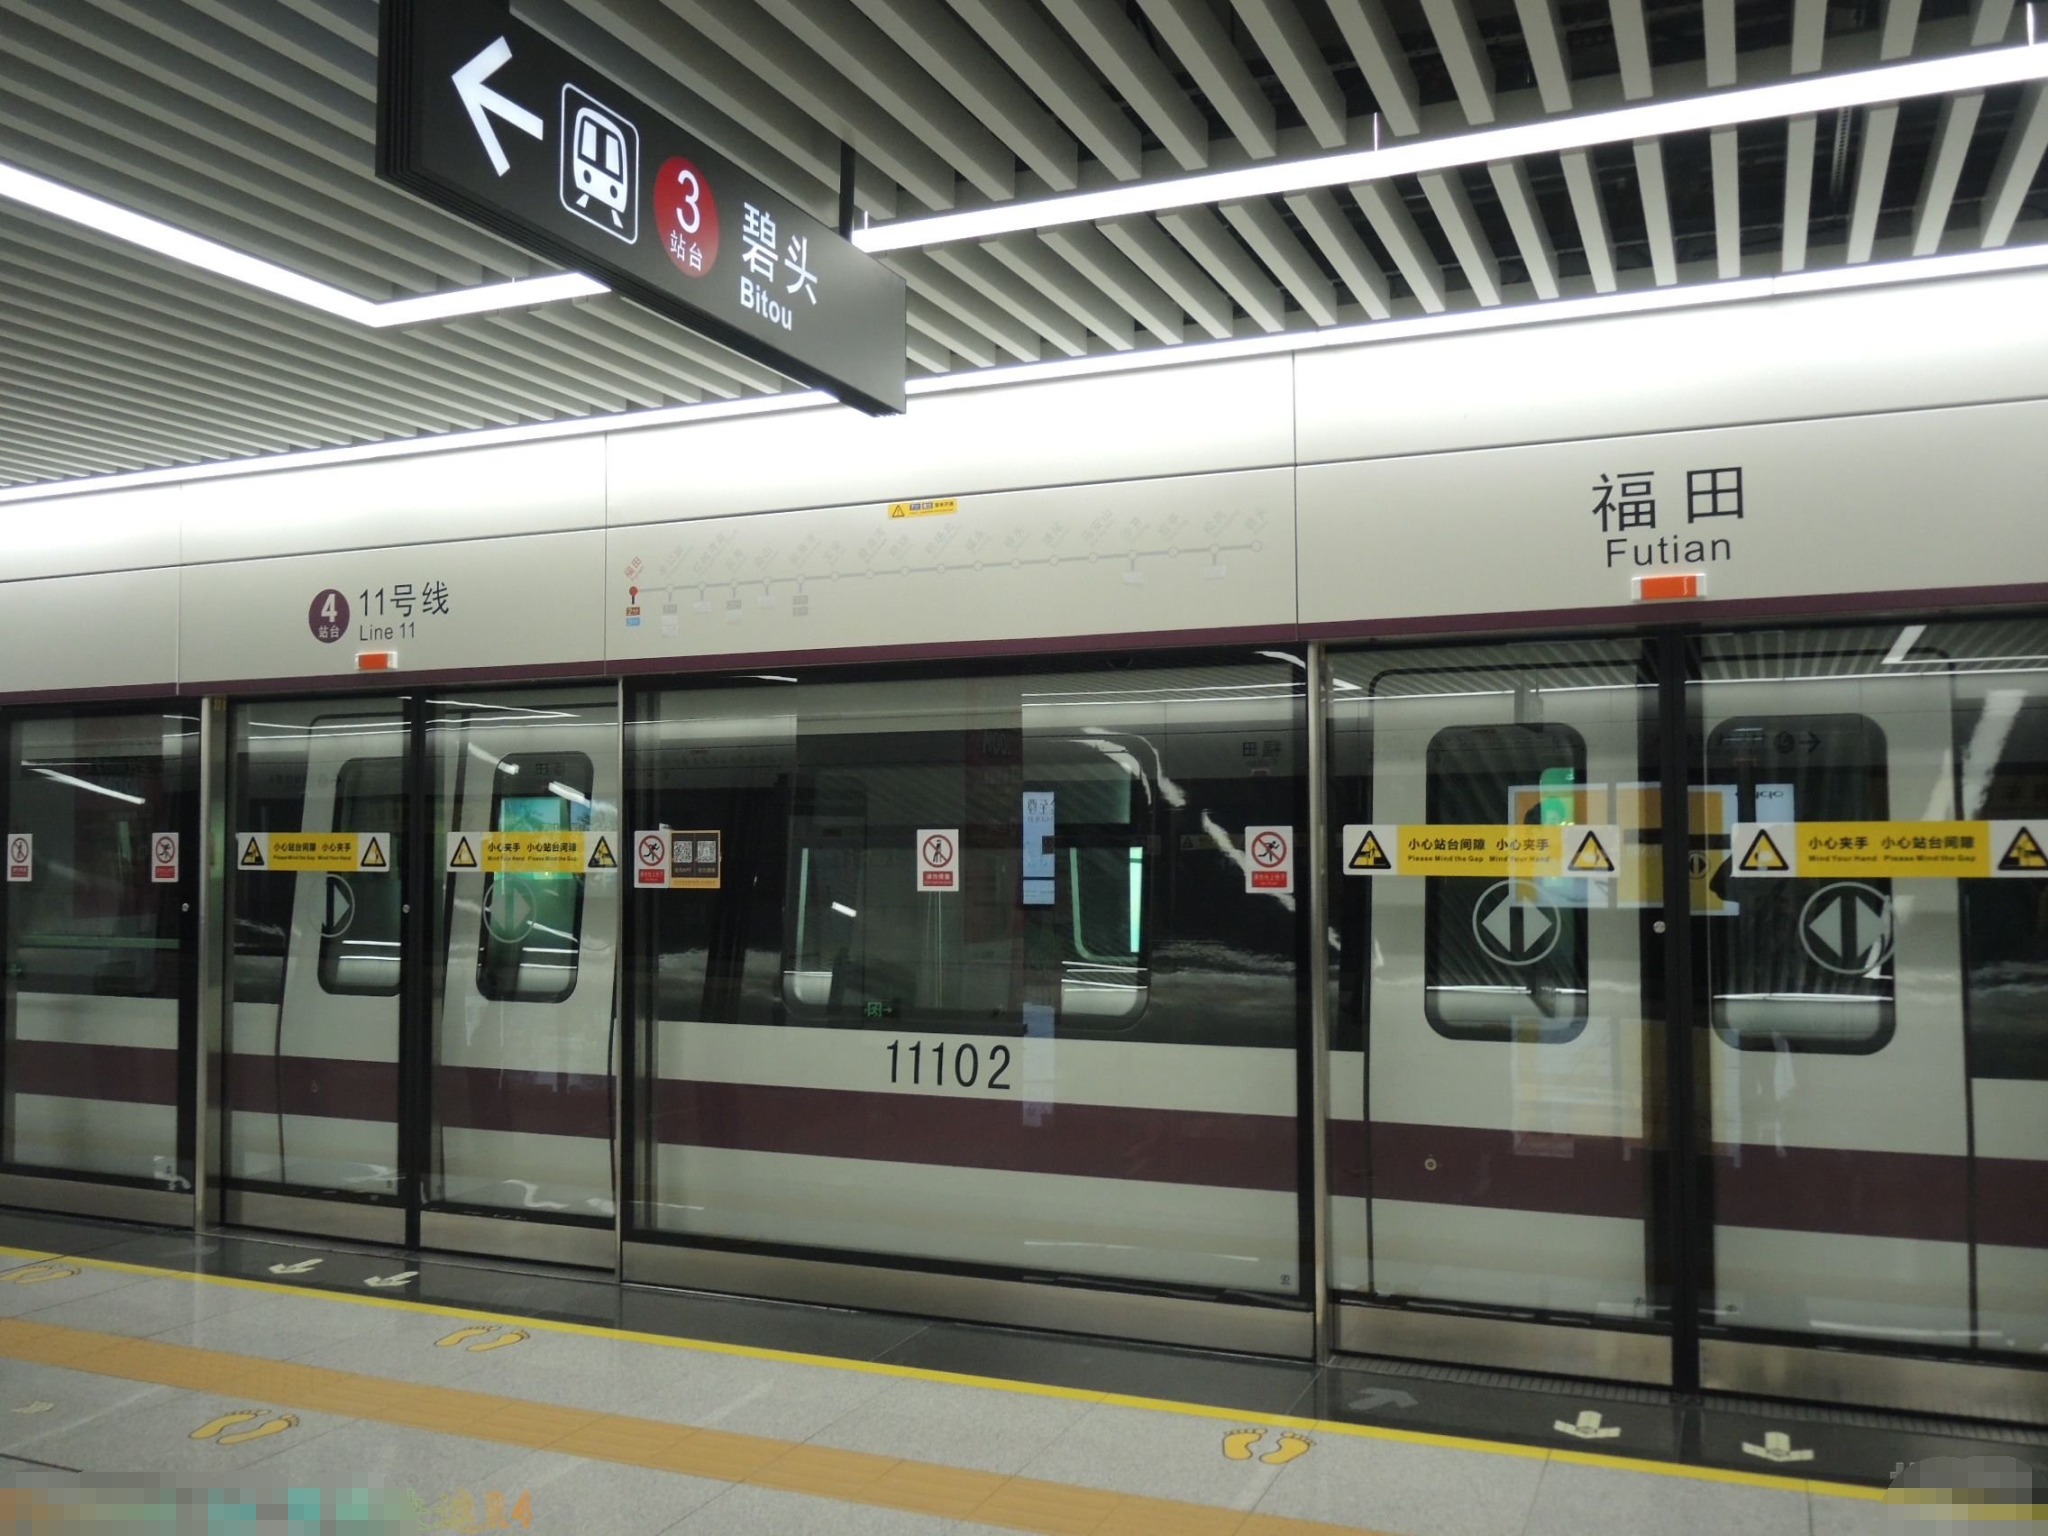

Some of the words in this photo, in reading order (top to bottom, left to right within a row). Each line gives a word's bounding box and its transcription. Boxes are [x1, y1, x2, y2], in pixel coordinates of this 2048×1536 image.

[676, 169, 701, 234] 3
[670, 229, 703, 272] 站台
[742, 202, 818, 305] 碧头
[740, 275, 792, 331] Bitou
[1592, 466, 1744, 532] 福田
[1606, 534, 1731, 568] Futian
[320, 593, 338, 623] 4
[359, 580, 450, 617] 11号线
[318, 625, 340, 639] 站台
[359, 624, 394, 641] Line
[399, 621, 416, 639] 11
[1408, 838, 1486, 851] 小心站台间隙
[1496, 838, 1550, 851] 小心夹手
[1809, 836, 1869, 850] 小心夹手
[1882, 836, 1975, 850] 小心站台间隙
[886, 1039, 1011, 1090] 11102
